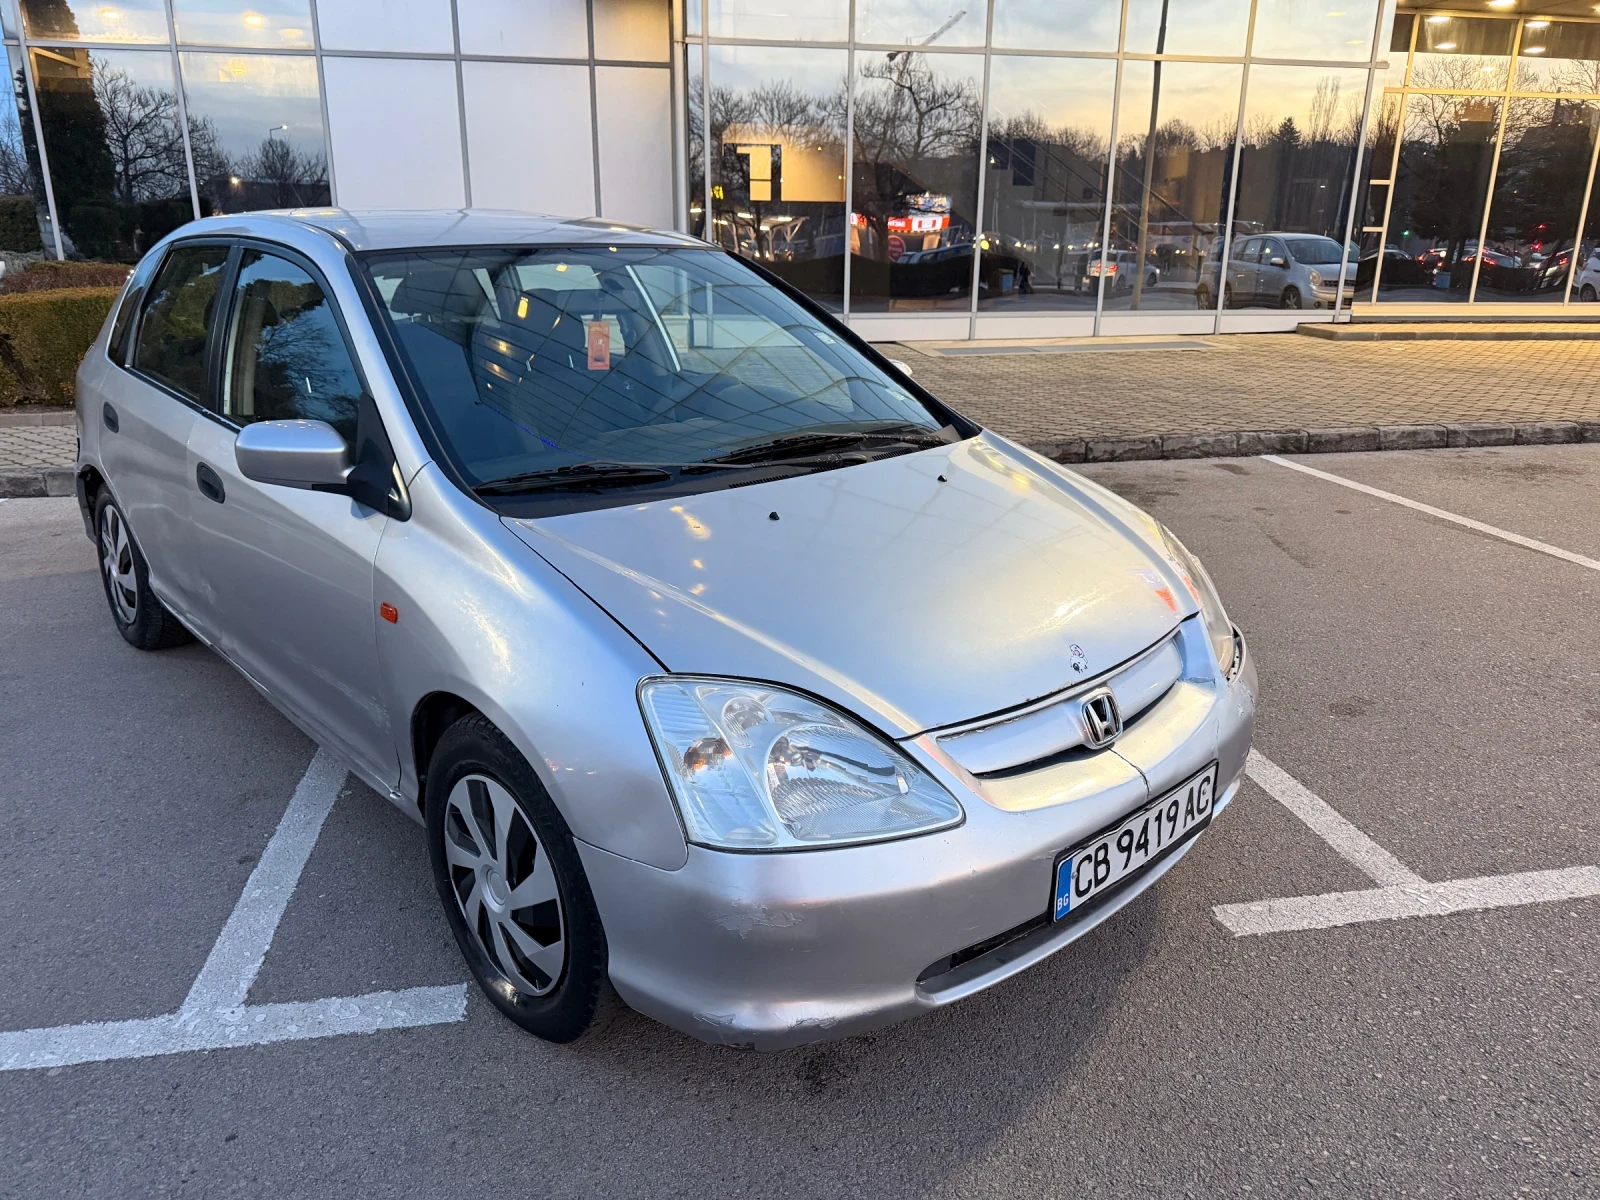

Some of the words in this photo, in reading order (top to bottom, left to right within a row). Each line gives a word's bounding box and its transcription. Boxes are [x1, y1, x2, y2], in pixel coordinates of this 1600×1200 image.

[1074, 843, 1111, 898] CB
[1116, 799, 1180, 871] 9419
[1182, 775, 1211, 829] AC
[1057, 893, 1069, 911] BG
